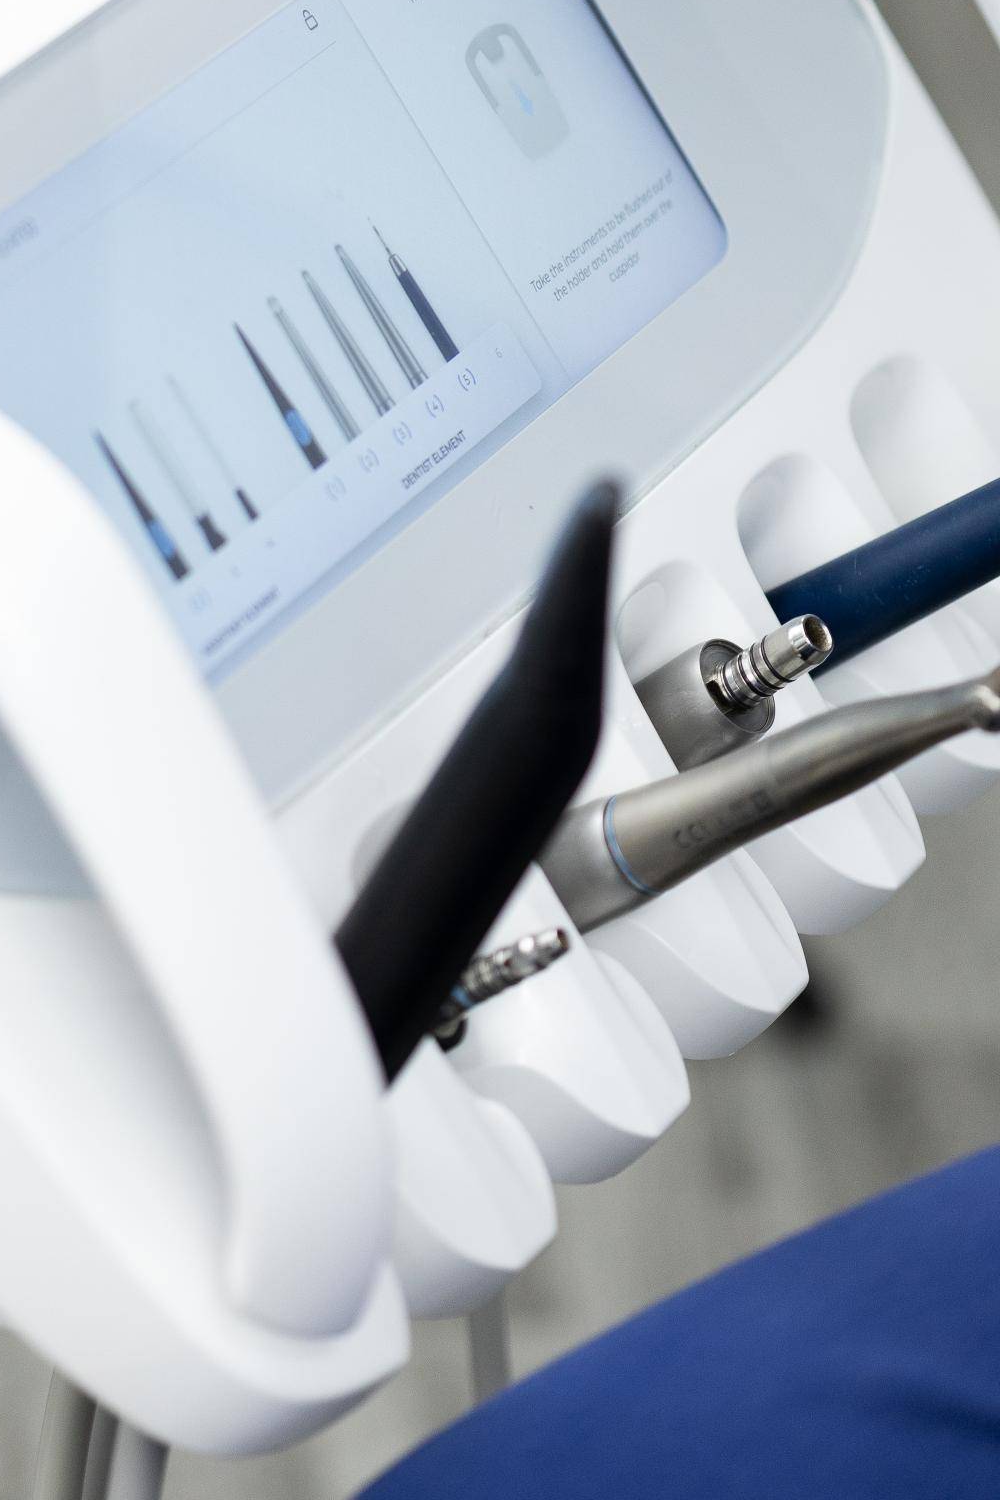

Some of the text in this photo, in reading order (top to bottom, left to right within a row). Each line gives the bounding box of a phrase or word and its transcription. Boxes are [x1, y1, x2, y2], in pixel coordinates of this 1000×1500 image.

[529, 272, 552, 293] Take
[549, 260, 565, 279] the
[563, 225, 609, 266] instruments
[605, 217, 617, 232] to
[614, 210, 627, 226] be
[553, 285, 569, 302] the
[567, 263, 593, 289] holder
[592, 251, 608, 271] and
[606, 238, 625, 260] hold
[622, 221, 646, 244] them
[608, 250, 641, 283] cuspidor
[425, 394, 445, 419] (4)
[457, 367, 478, 392] (5)
[401, 429, 467, 490] DENTIST ELEMENT
